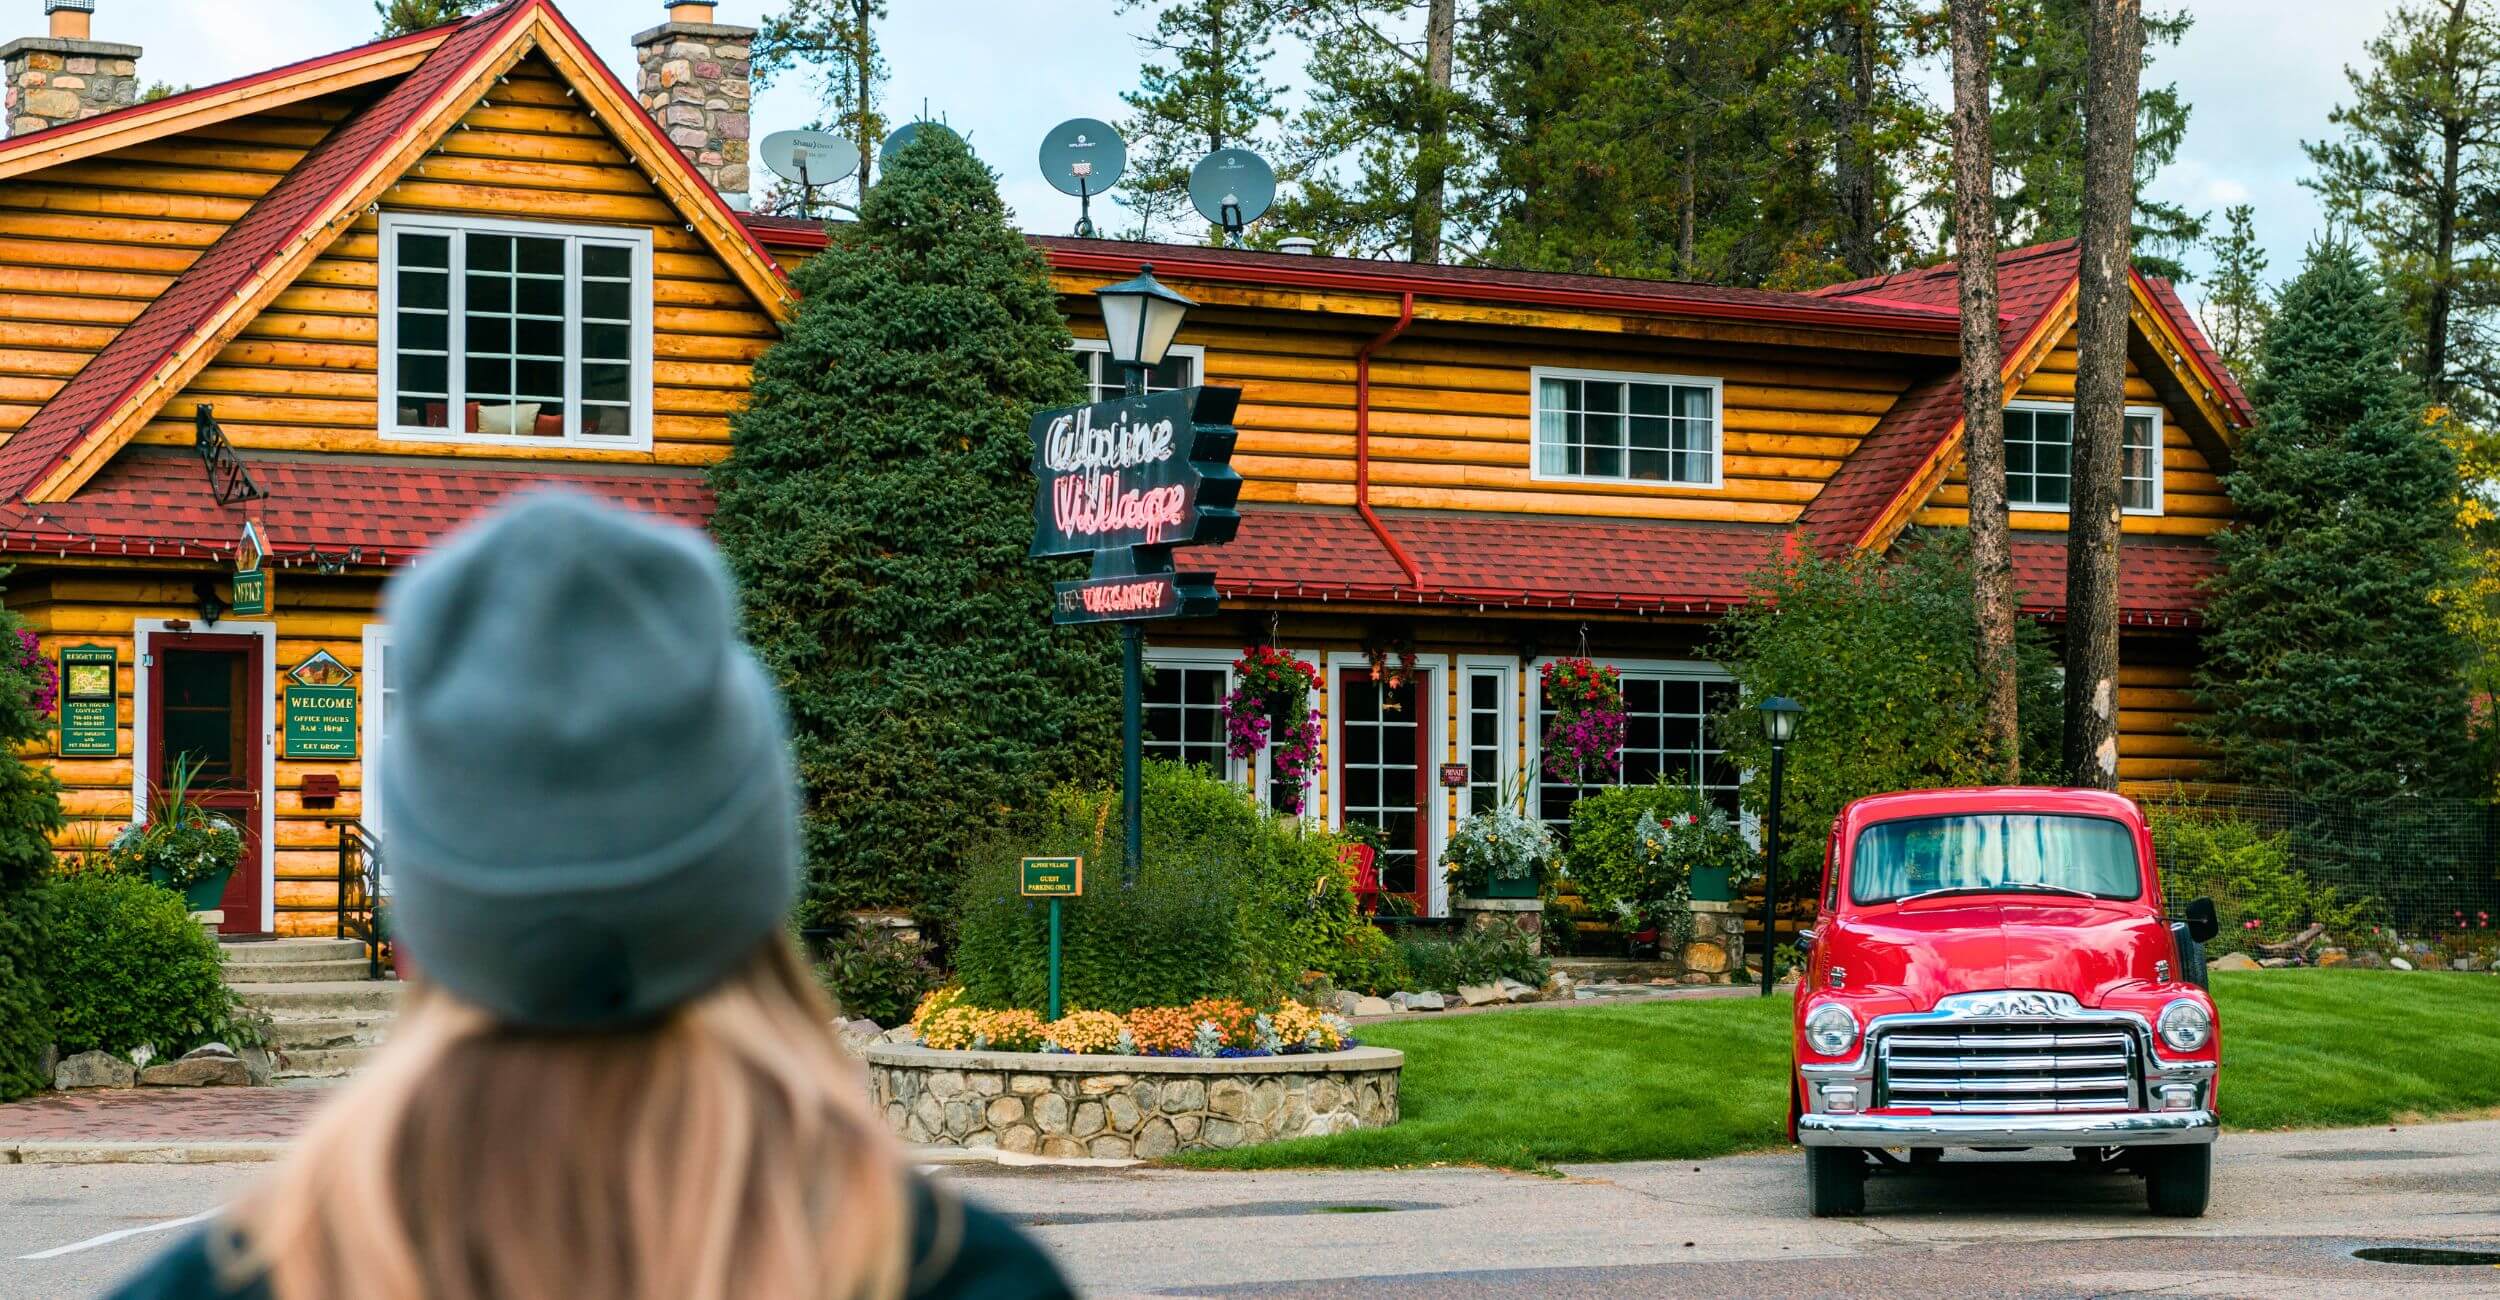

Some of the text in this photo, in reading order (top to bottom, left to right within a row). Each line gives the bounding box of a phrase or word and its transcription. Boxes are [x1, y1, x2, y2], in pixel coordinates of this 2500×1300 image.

[1045, 407, 1175, 508] Alpine
[1053, 471, 1186, 544] Village
[234, 582, 262, 602] OFFICE
[1083, 582, 1164, 612] VACANCY
[291, 697, 353, 708] WELCOME
[294, 715, 350, 723] OFFICE HOURS
